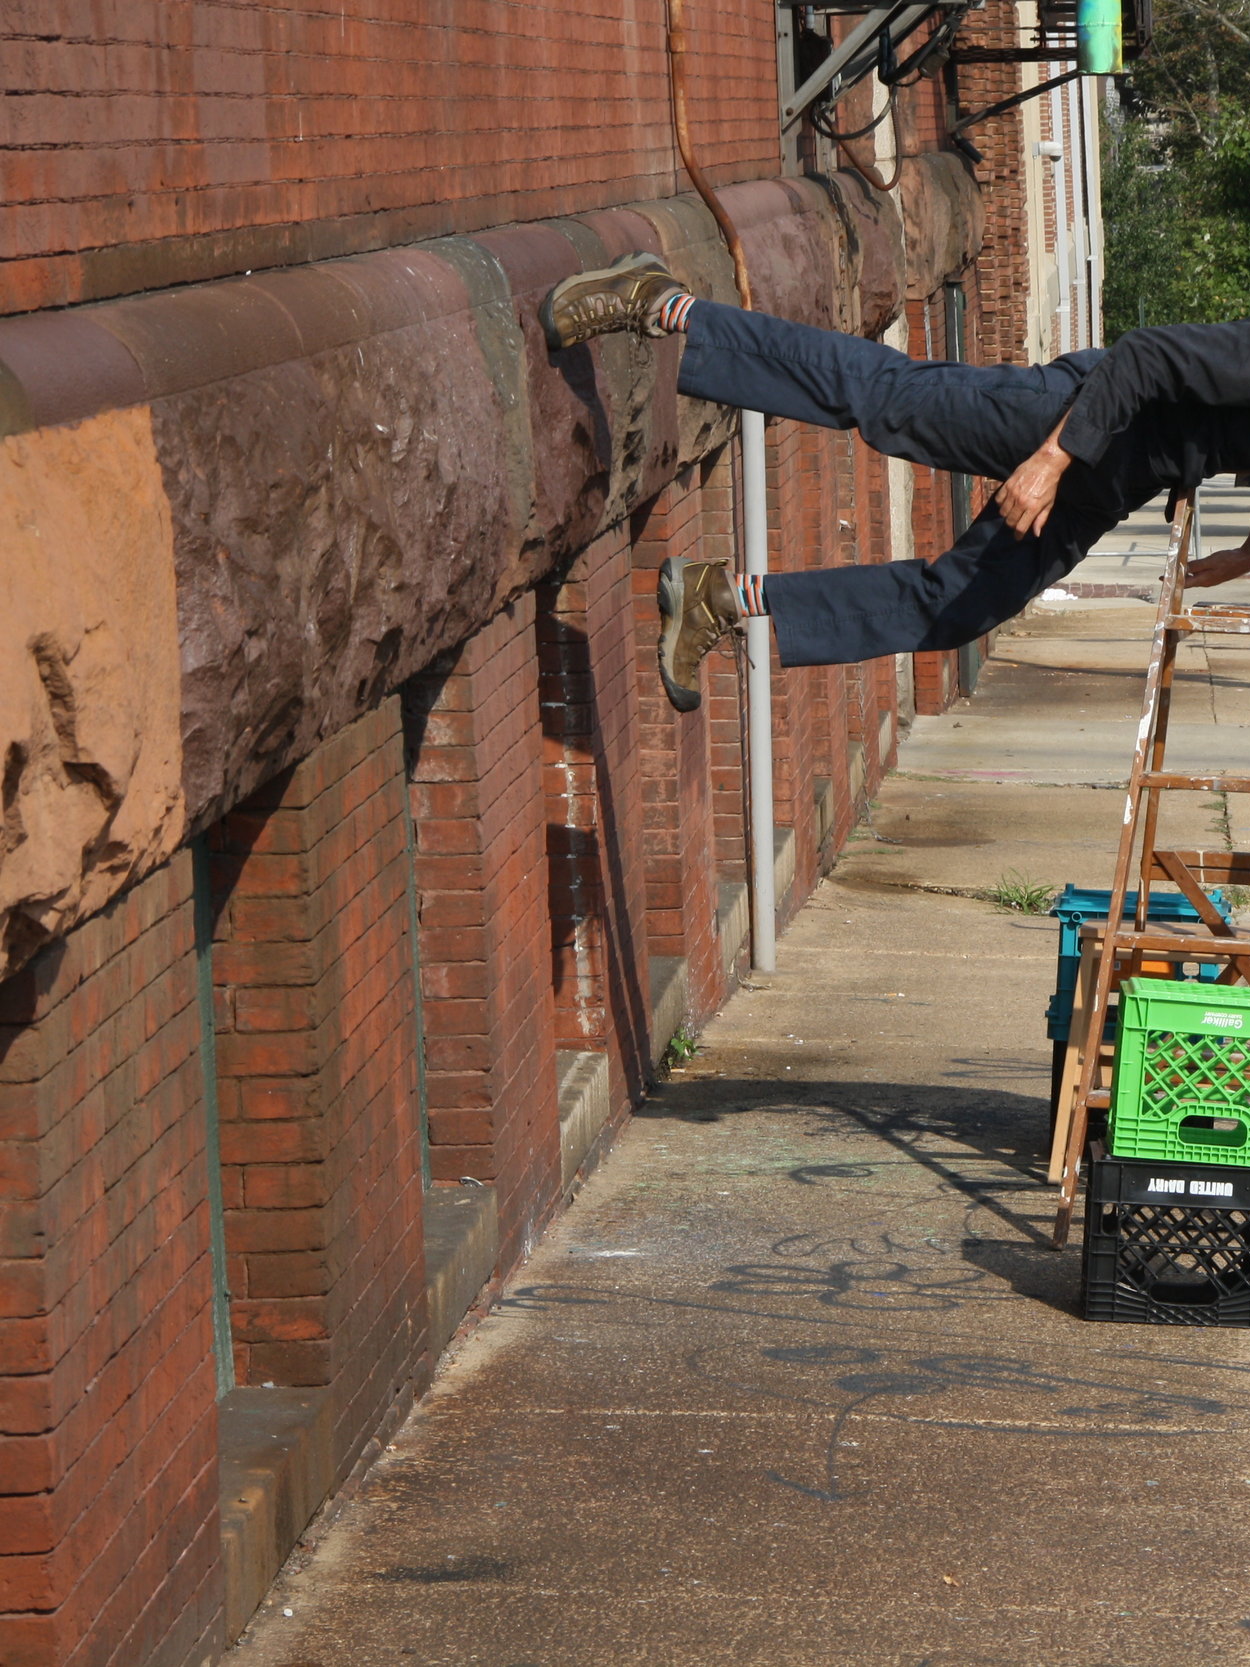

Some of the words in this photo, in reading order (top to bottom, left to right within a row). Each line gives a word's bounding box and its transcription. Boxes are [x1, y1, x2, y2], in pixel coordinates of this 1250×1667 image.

[1201, 1016, 1243, 1029] Galliker
[1147, 1177, 1185, 1194] DAIRY
[1189, 1180, 1233, 1197] UNITED
